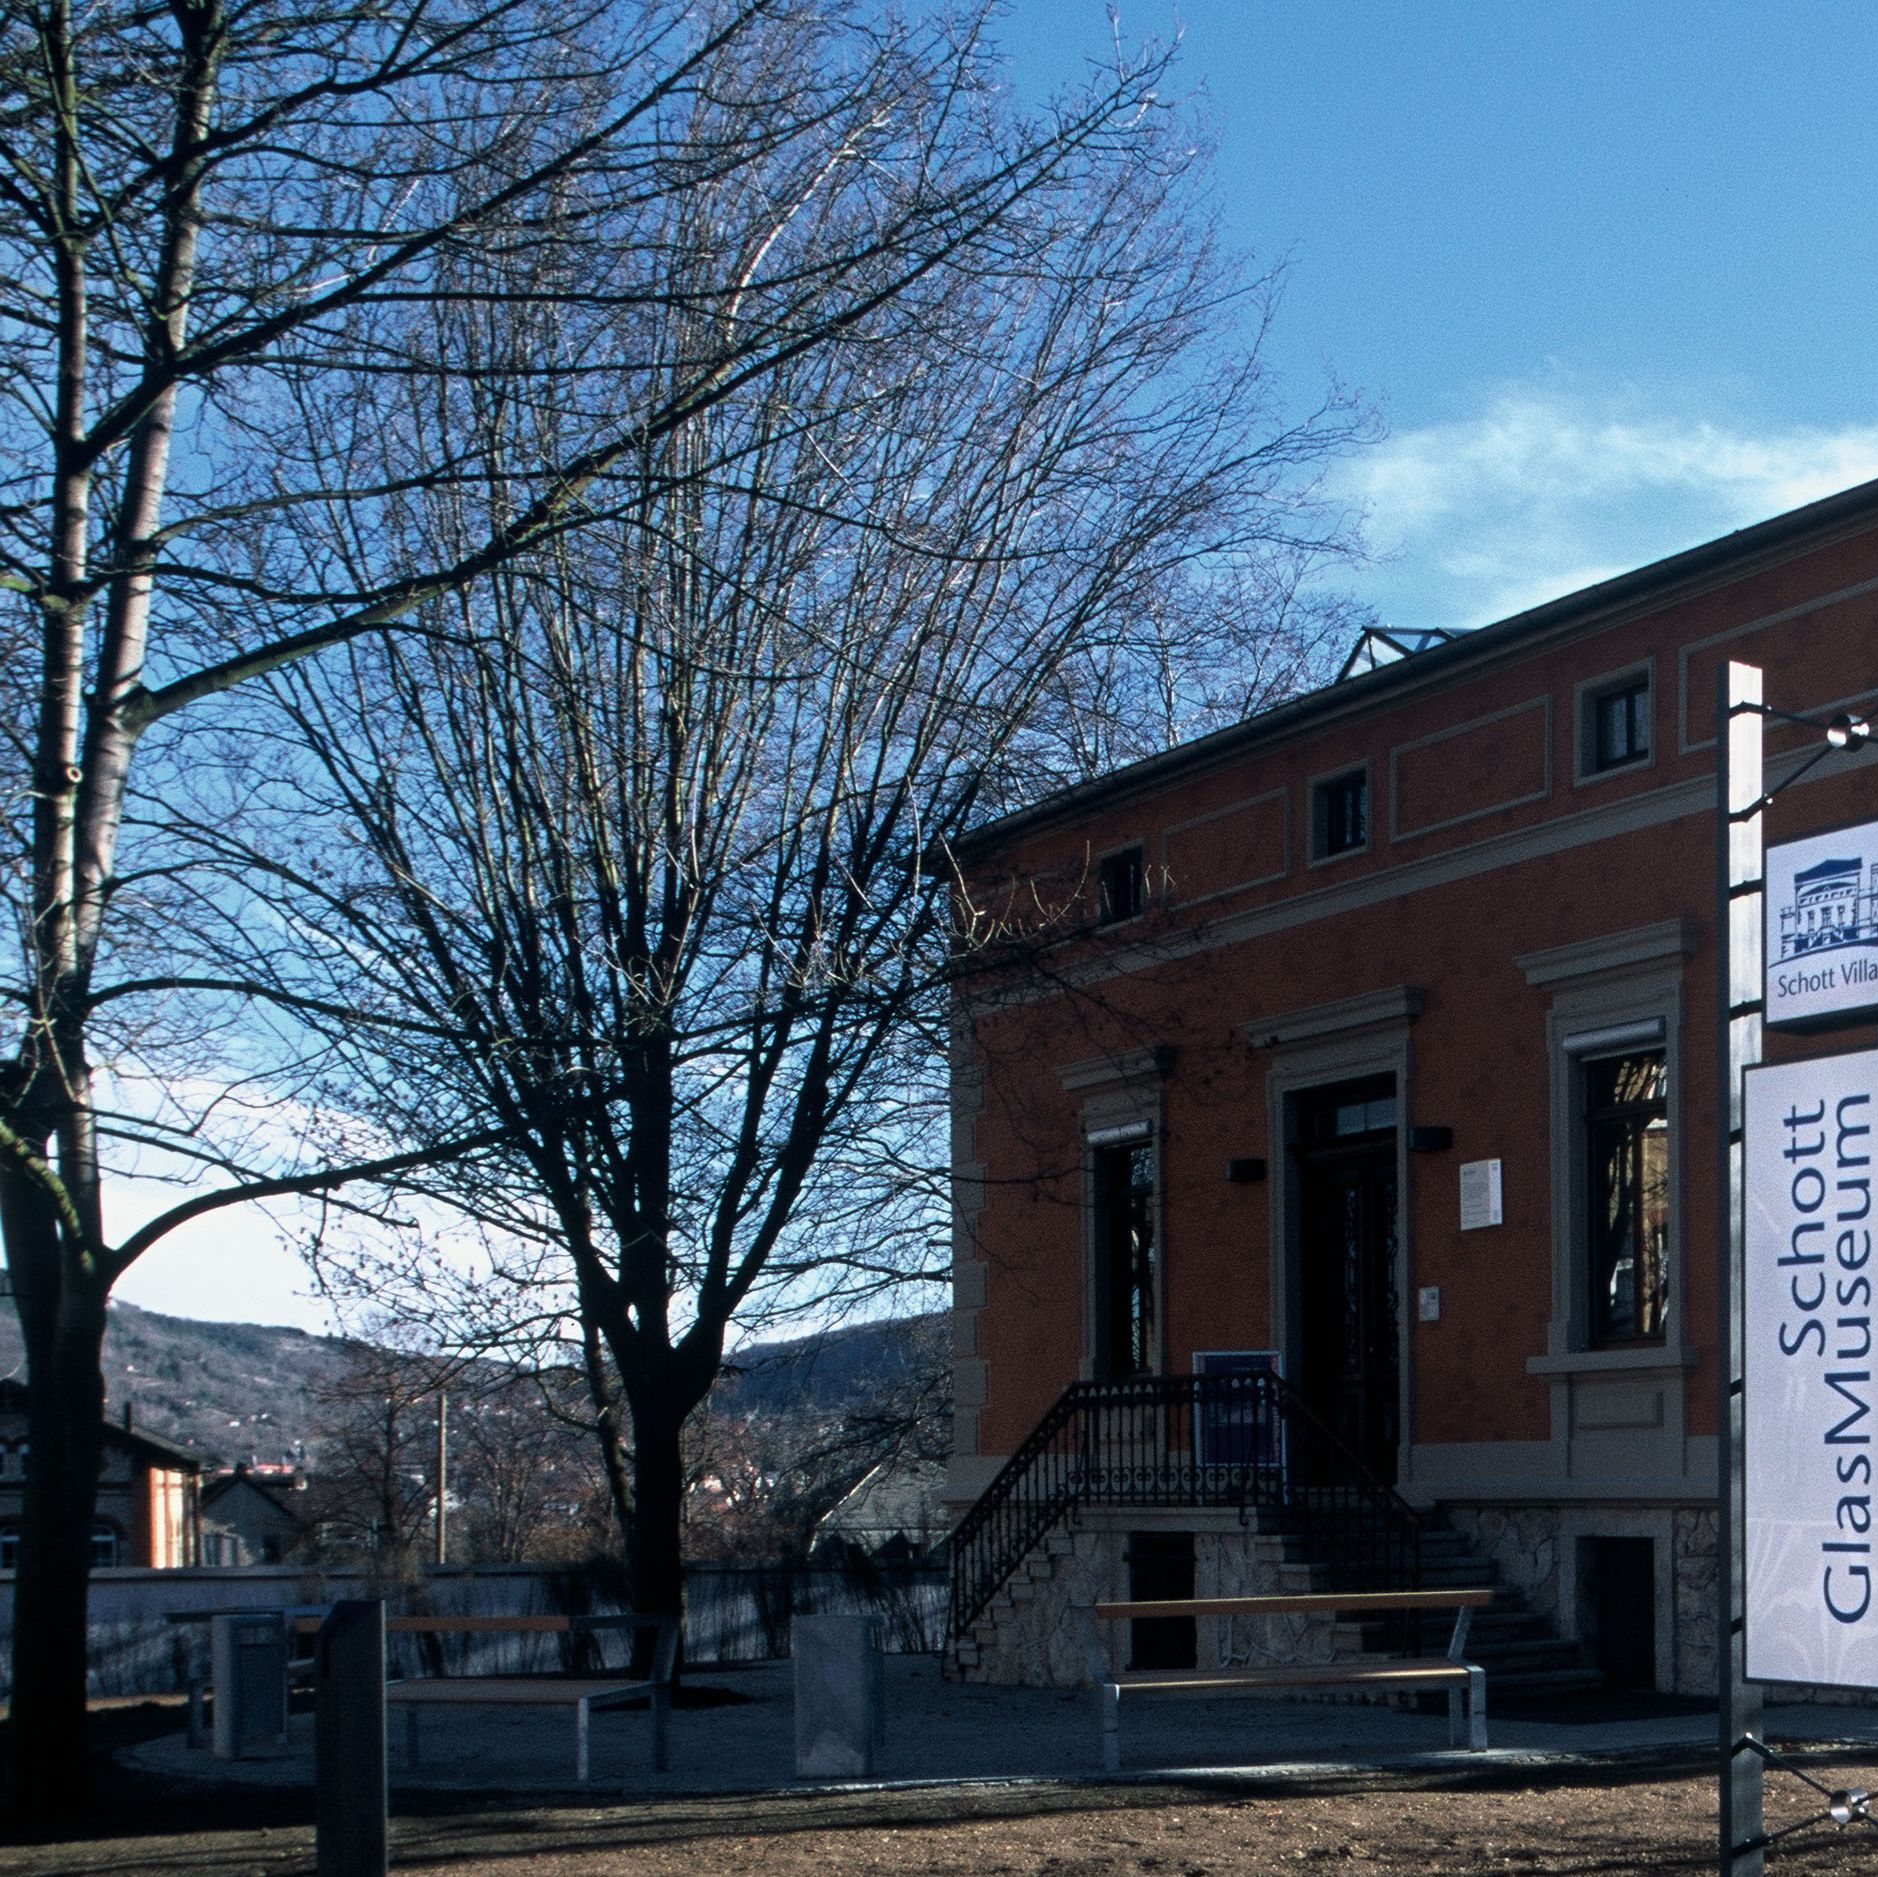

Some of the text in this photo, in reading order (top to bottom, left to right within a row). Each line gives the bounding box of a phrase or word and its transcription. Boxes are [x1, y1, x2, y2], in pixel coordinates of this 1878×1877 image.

[1777, 968, 1836, 998] Schott
[1776, 1098, 1826, 1358] Schott
[1821, 1093, 1873, 1625] GlasMuseum
